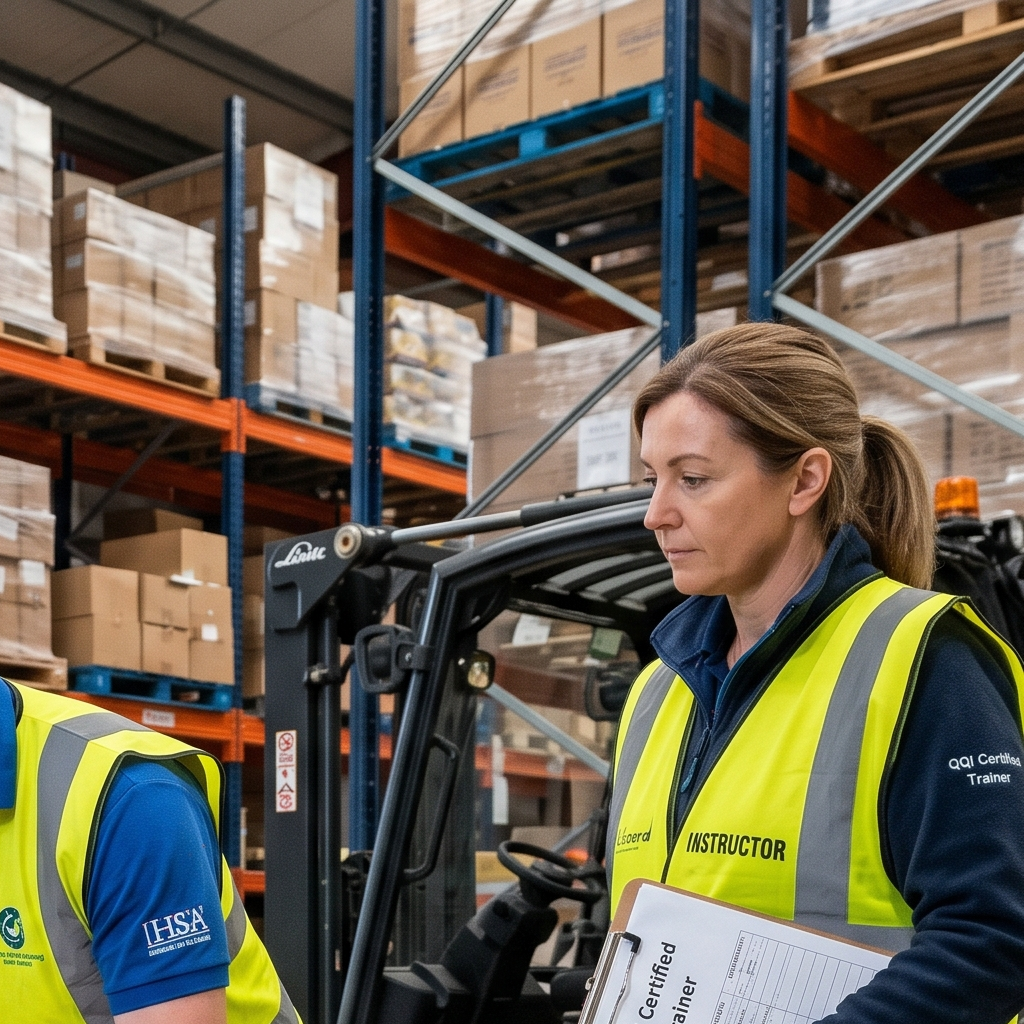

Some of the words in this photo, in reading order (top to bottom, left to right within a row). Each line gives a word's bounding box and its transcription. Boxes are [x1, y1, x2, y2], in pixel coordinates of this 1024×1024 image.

[948, 755, 974, 770] QQI
[966, 772, 1011, 786] Trainer
[686, 832, 787, 862] INSTRUCTOR
[638, 941, 677, 1020] Certified
